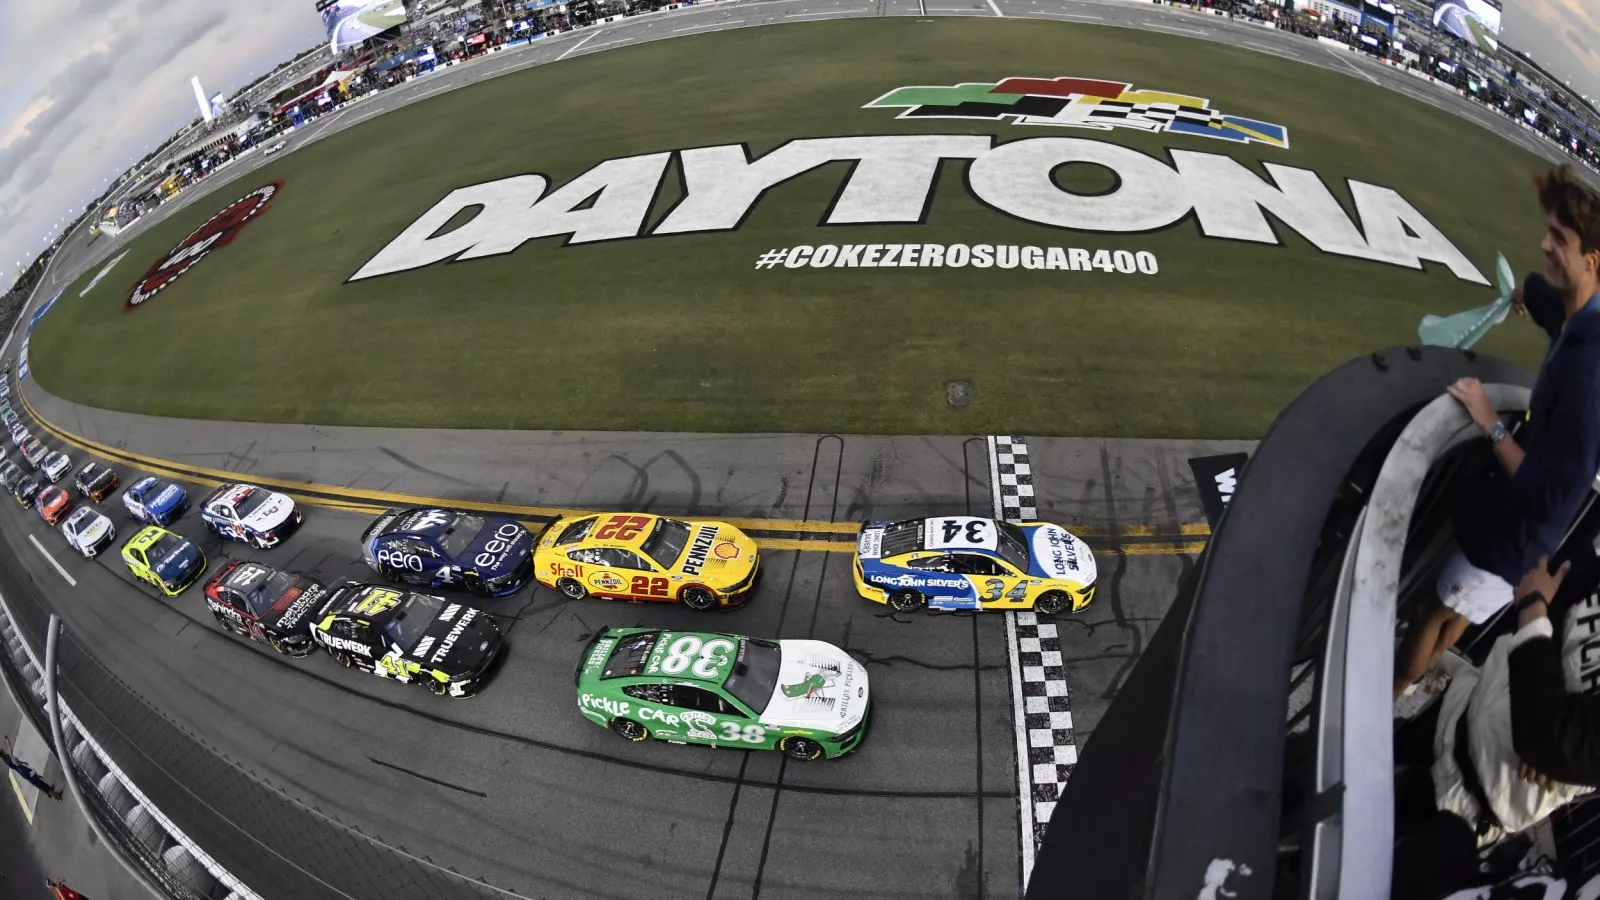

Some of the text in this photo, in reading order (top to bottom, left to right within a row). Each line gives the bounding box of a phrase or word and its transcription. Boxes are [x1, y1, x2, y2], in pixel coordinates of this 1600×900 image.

[346, 133, 1492, 287] DAYTONA
[754, 243, 1159, 276] #COKEZEROSUGAR400
[410, 509, 447, 531] 4
[595, 515, 652, 540] 22
[942, 519, 987, 544] 34
[475, 523, 519, 567] eero
[682, 524, 719, 576] PENNZOIL
[1047, 527, 1066, 575] LONG JOHN
[378, 549, 423, 572] eero
[491, 560, 501, 571] The
[550, 562, 584, 578] Shell
[233, 566, 266, 586] 14
[435, 565, 454, 584] 4
[594, 578, 623, 586] PENNZOIL
[631, 575, 669, 597] 22
[870, 574, 898, 587] LONG
[898, 575, 926, 588] JOHN
[353, 586, 403, 616] 41
[979, 578, 1029, 603] 34
[207, 597, 243, 623] mahindra
[276, 583, 320, 629] mahindra
[284, 588, 320, 627] COMPACT
[287, 589, 327, 630] TRACTORS
[317, 629, 374, 659] TRUEWERK
[430, 606, 480, 664] TRUEWERK
[380, 654, 413, 679] 41
[648, 655, 661, 674] CAR
[660, 635, 735, 678] 38
[638, 707, 680, 728] CAR
[717, 721, 766, 744] 38
